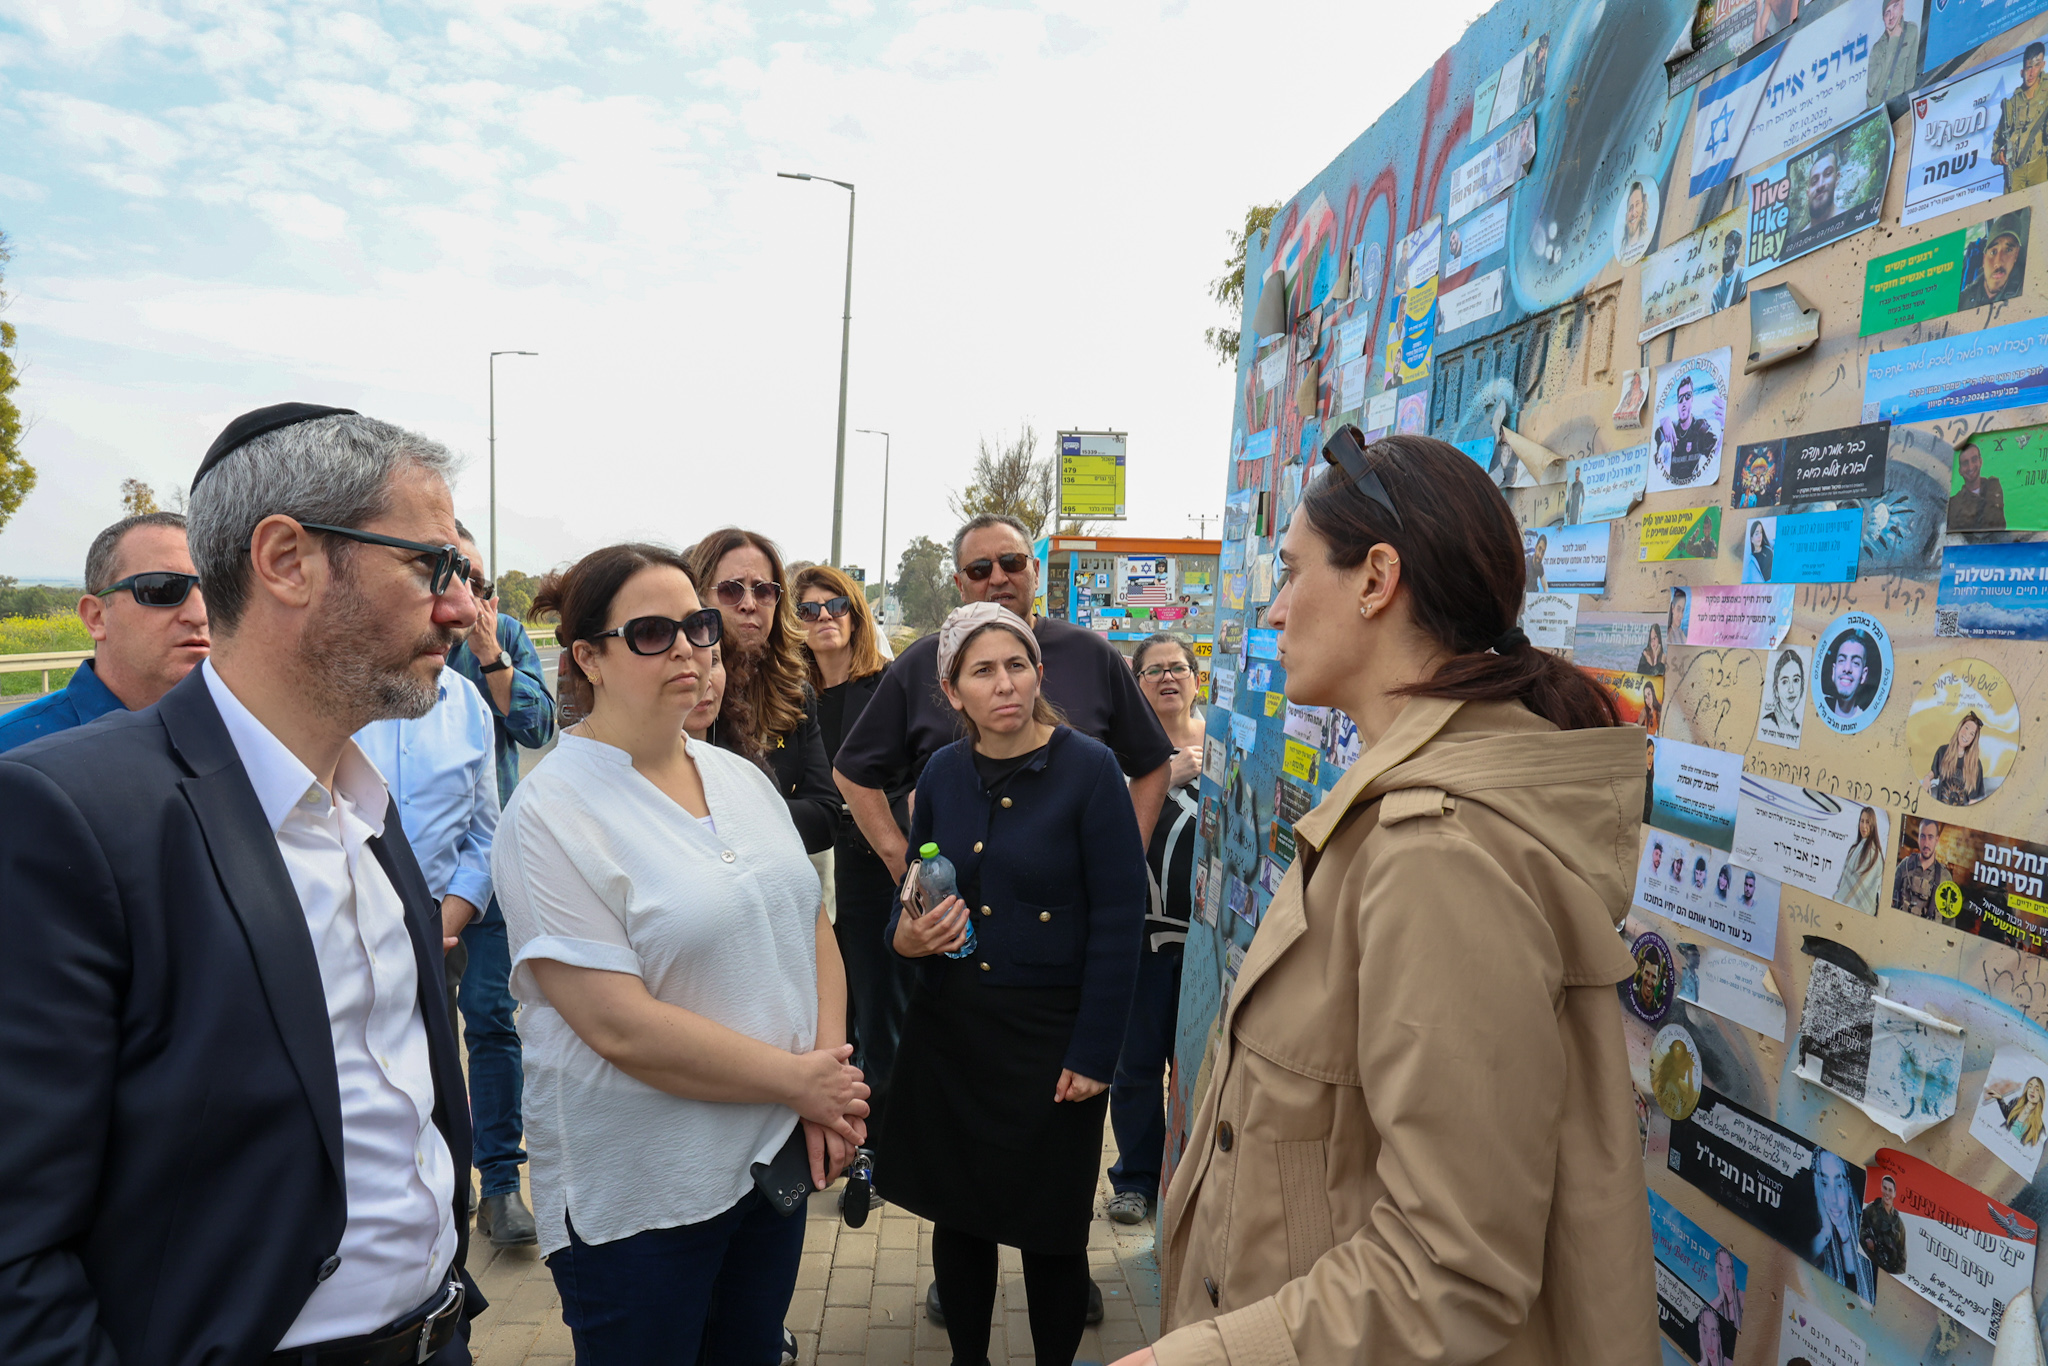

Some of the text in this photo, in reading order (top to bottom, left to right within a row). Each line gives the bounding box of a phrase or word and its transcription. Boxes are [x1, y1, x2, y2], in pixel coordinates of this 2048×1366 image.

[1836, 80, 1846, 91] של
[1754, 178, 1790, 212] live
[1752, 201, 1789, 234] like
[1750, 228, 1786, 260] ilay
[1884, 259, 1906, 273] קשים
[1900, 261, 1954, 285] עושים אנשים
[1909, 387, 1925, 398] בקרב
[1801, 446, 1820, 462] תודה
[1847, 440, 1866, 454] כבר
[1841, 454, 1873, 475] לבורא
[1064, 476, 1076, 484] 136
[2009, 567, 2035, 581] את
[1953, 586, 2038, 596] חיים ששווה לחיות
[1195, 645, 1213, 656] 479
[1794, 848, 1808, 862] אבי
[1811, 854, 1819, 868] בן
[1822, 858, 1832, 872] חן
[1644, 892, 1663, 908] בתוכנו
[1676, 907, 1686, 917] הם
[1688, 911, 1706, 925] אותם
[1983, 897, 2037, 932] של גיבור ישראל
[1708, 918, 1726, 933] נזכור
[1728, 925, 1740, 938] עוד
[1983, 910, 2026, 940] רוזנשטיין
[1743, 930, 1752, 943] כל
[2029, 933, 2041, 946] בר
[1717, 1157, 1739, 1184] רובי
[1742, 1172, 1755, 1194] בן
[1757, 1182, 1780, 1208] עדן
[1938, 1206, 1968, 1240] אתה
[1690, 1238, 1698, 1250] בן
[1969, 1225, 1996, 1253] עוד
[1661, 1236, 1708, 1282] my Best Life
[1698, 1244, 1710, 1260] עדן
[1961, 1256, 1994, 1287] יהיה
[1810, 1327, 1830, 1346] חינם
